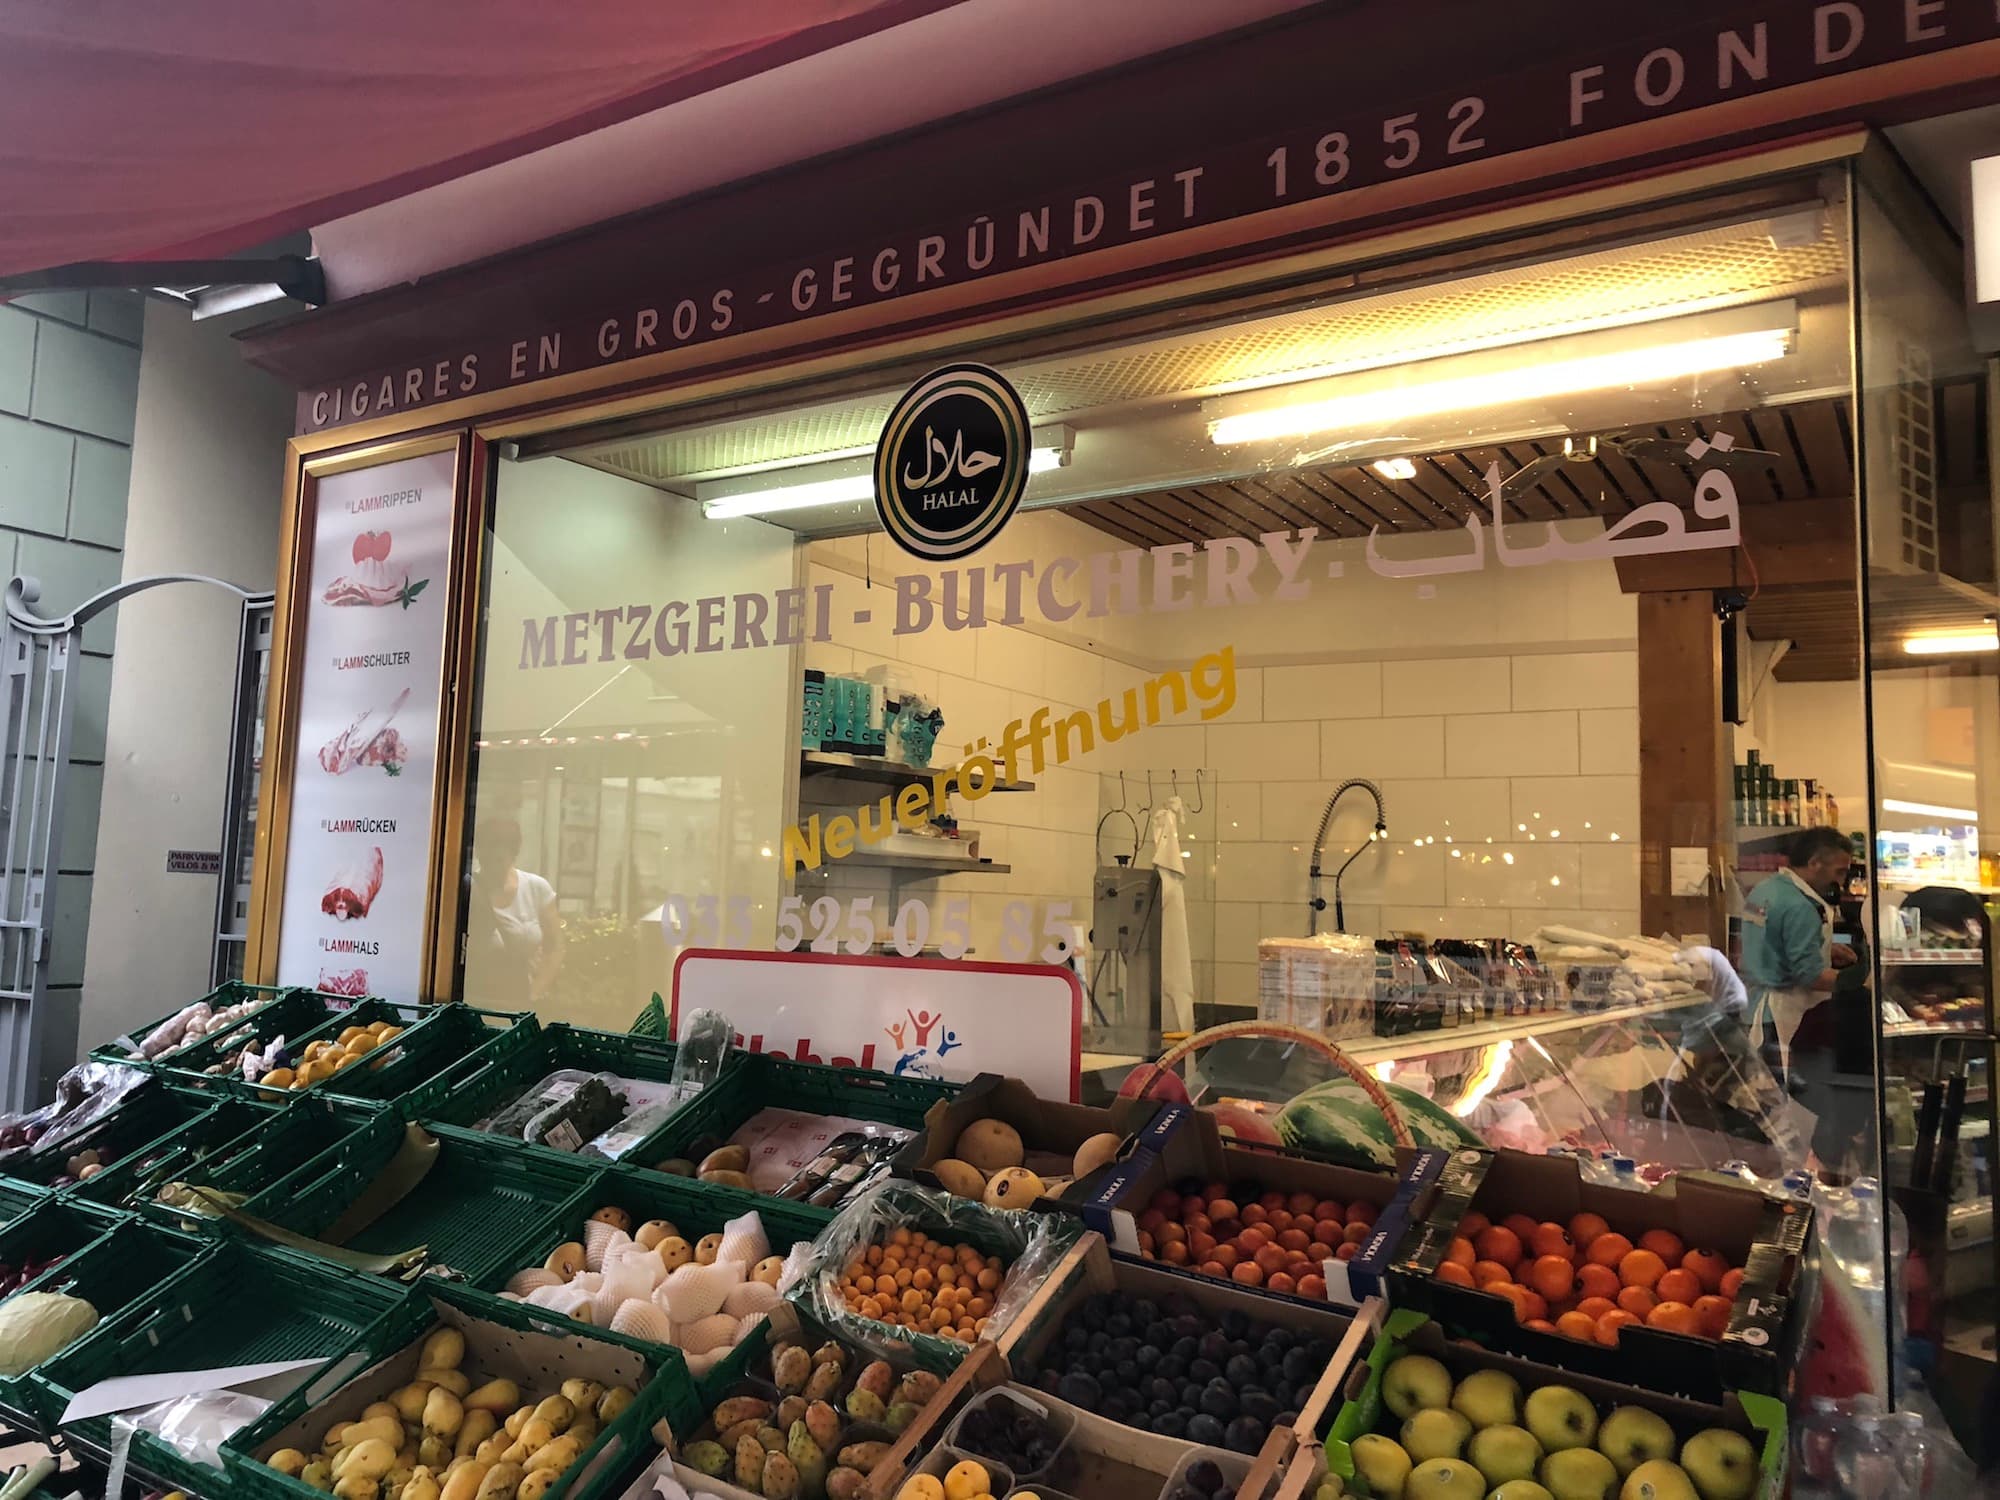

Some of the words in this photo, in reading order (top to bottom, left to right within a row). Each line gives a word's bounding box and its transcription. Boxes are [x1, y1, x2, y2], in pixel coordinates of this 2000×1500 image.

[312, 354, 479, 426] CIGARES
[509, 332, 562, 381] EN
[598, 289, 734, 358] GROS
[791, 166, 1204, 311] GEGRÜNDET
[1266, 96, 1486, 198] 1852
[1569, 0, 2000, 127] FONDE
[903, 424, 1002, 490] حلال
[351, 487, 422, 514] LAMMRIPPEN
[922, 488, 980, 511] HALAL
[1365, 431, 1742, 599] قصاب
[518, 584, 833, 670] METZGEREI
[892, 527, 1319, 636] BUTCHERY
[338, 651, 410, 670] LAMMSCHULTER
[783, 644, 1237, 880] Neueröffnung
[327, 817, 397, 833] LAMMRÜCKEN
[661, 893, 753, 948] 033
[776, 893, 875, 956] 525
[893, 898, 971, 959] 05
[1000, 901, 1074, 965] 85
[325, 938, 380, 955] LAMMHALS
[1154, 1109, 1181, 1134] VIGNOLA
[1097, 1177, 1127, 1203] VIGNOLA
